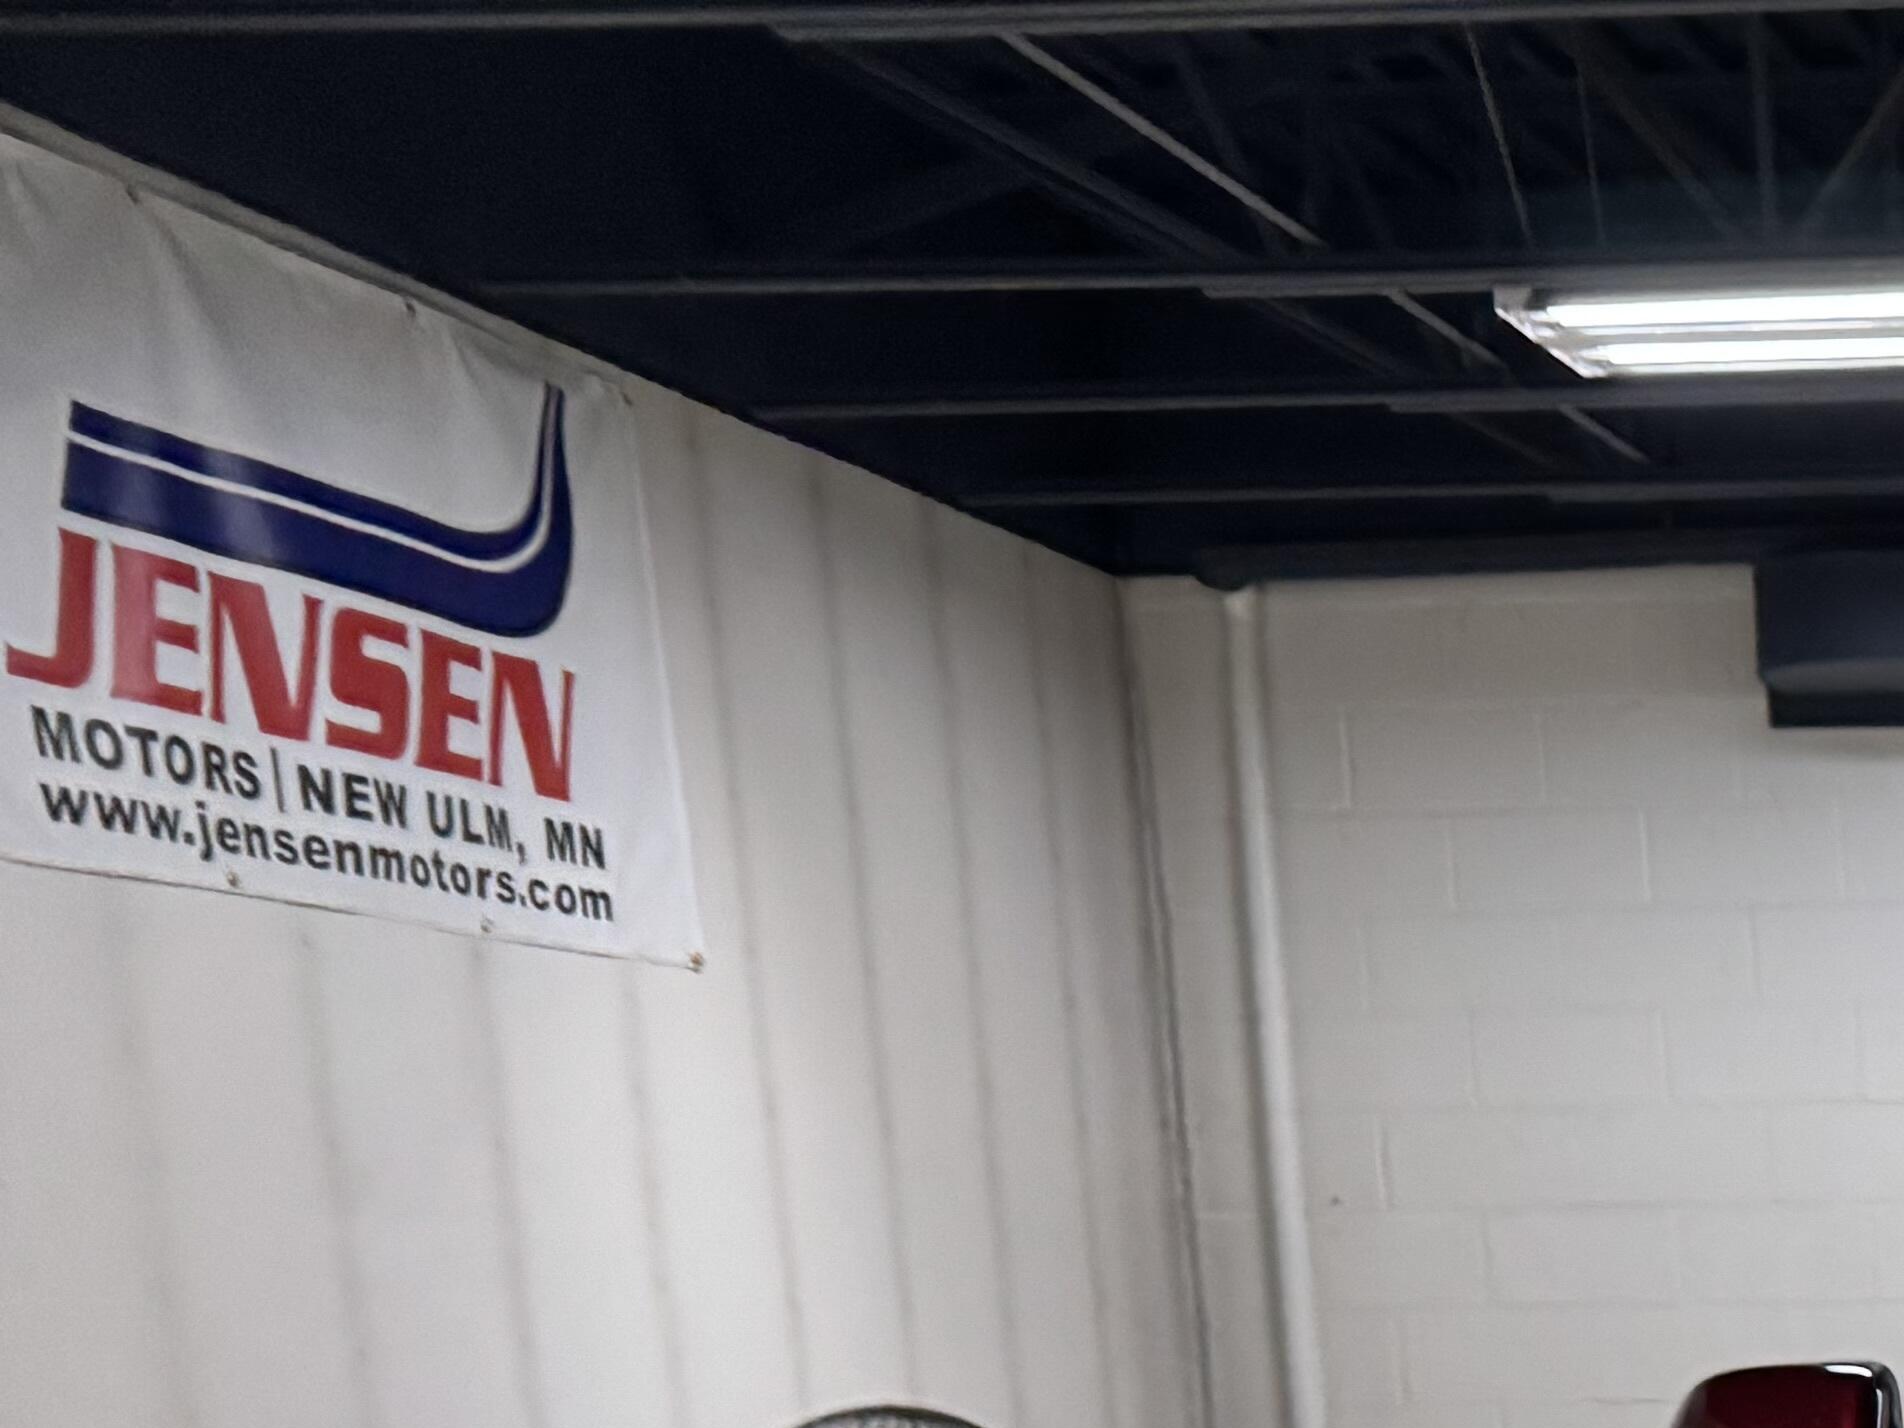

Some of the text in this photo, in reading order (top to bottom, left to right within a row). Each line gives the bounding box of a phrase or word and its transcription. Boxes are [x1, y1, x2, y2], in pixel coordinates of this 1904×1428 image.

[5, 526, 575, 802] JENSEN
[30, 704, 607, 870] MOTORS NEW ULM, MN
[38, 780, 614, 922] www.jensenmotors.com
